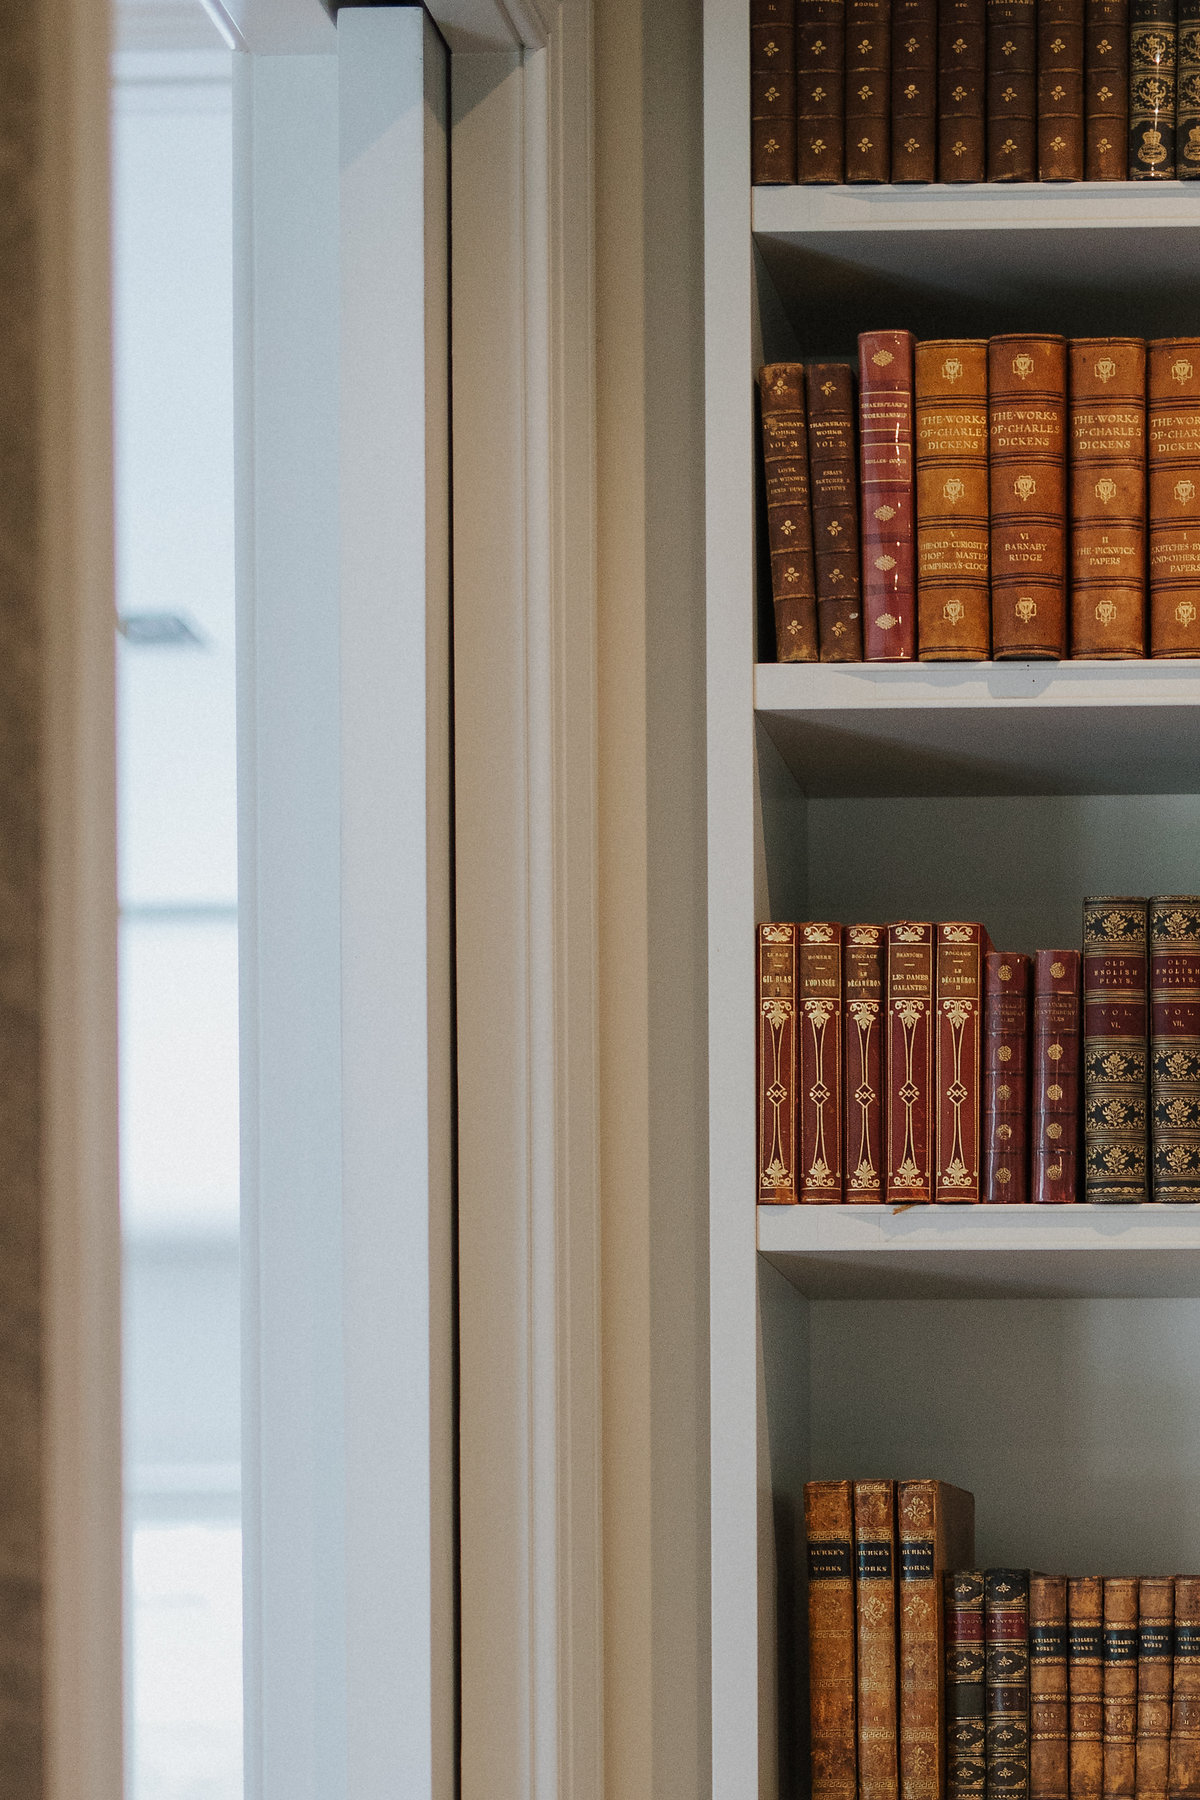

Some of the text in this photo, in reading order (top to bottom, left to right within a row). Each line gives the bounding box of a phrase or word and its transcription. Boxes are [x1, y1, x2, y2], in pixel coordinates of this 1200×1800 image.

[928, 440, 979, 450] DICKENS
[998, 437, 1050, 447] DICKENS
[1079, 440, 1131, 450] DICKENS
[1020, 532, 1029, 540] VI
[1004, 543, 1047, 551] BARNABY
[1009, 553, 1043, 562] RUDGE
[1089, 557, 1121, 566] PAPERS
[1170, 564, 1200, 572] PAPERS
[1156, 967, 1200, 975] ENGLISH
[902, 1548, 932, 1556] BURKE'S
